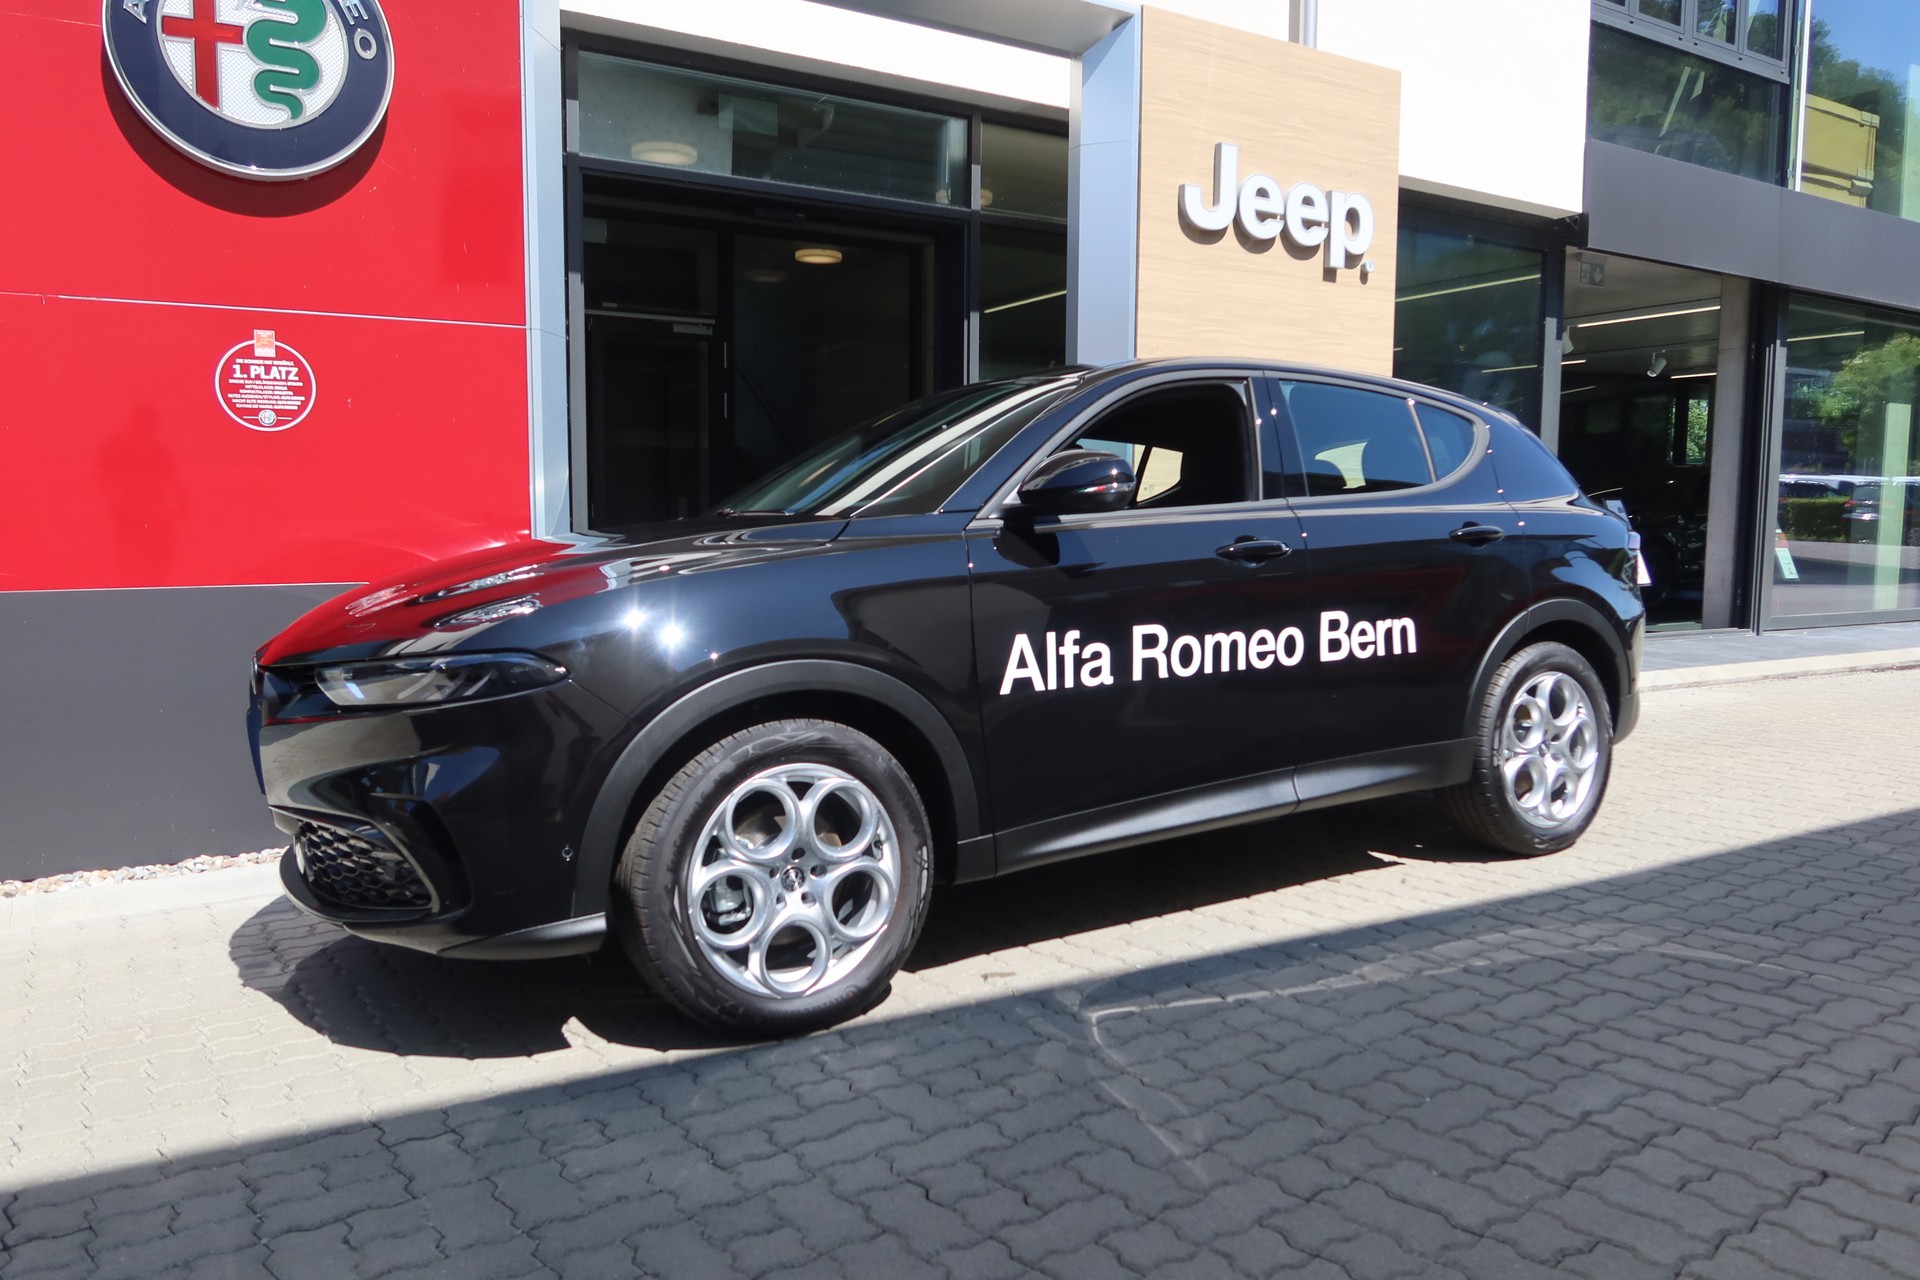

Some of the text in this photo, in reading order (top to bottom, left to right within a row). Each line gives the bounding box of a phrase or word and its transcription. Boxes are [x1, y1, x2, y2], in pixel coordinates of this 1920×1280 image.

[1178, 142, 1375, 271] Jeep
[232, 364, 299, 381] 1. PLATZ
[1000, 610, 1417, 695] Alfa Romeo Bern
